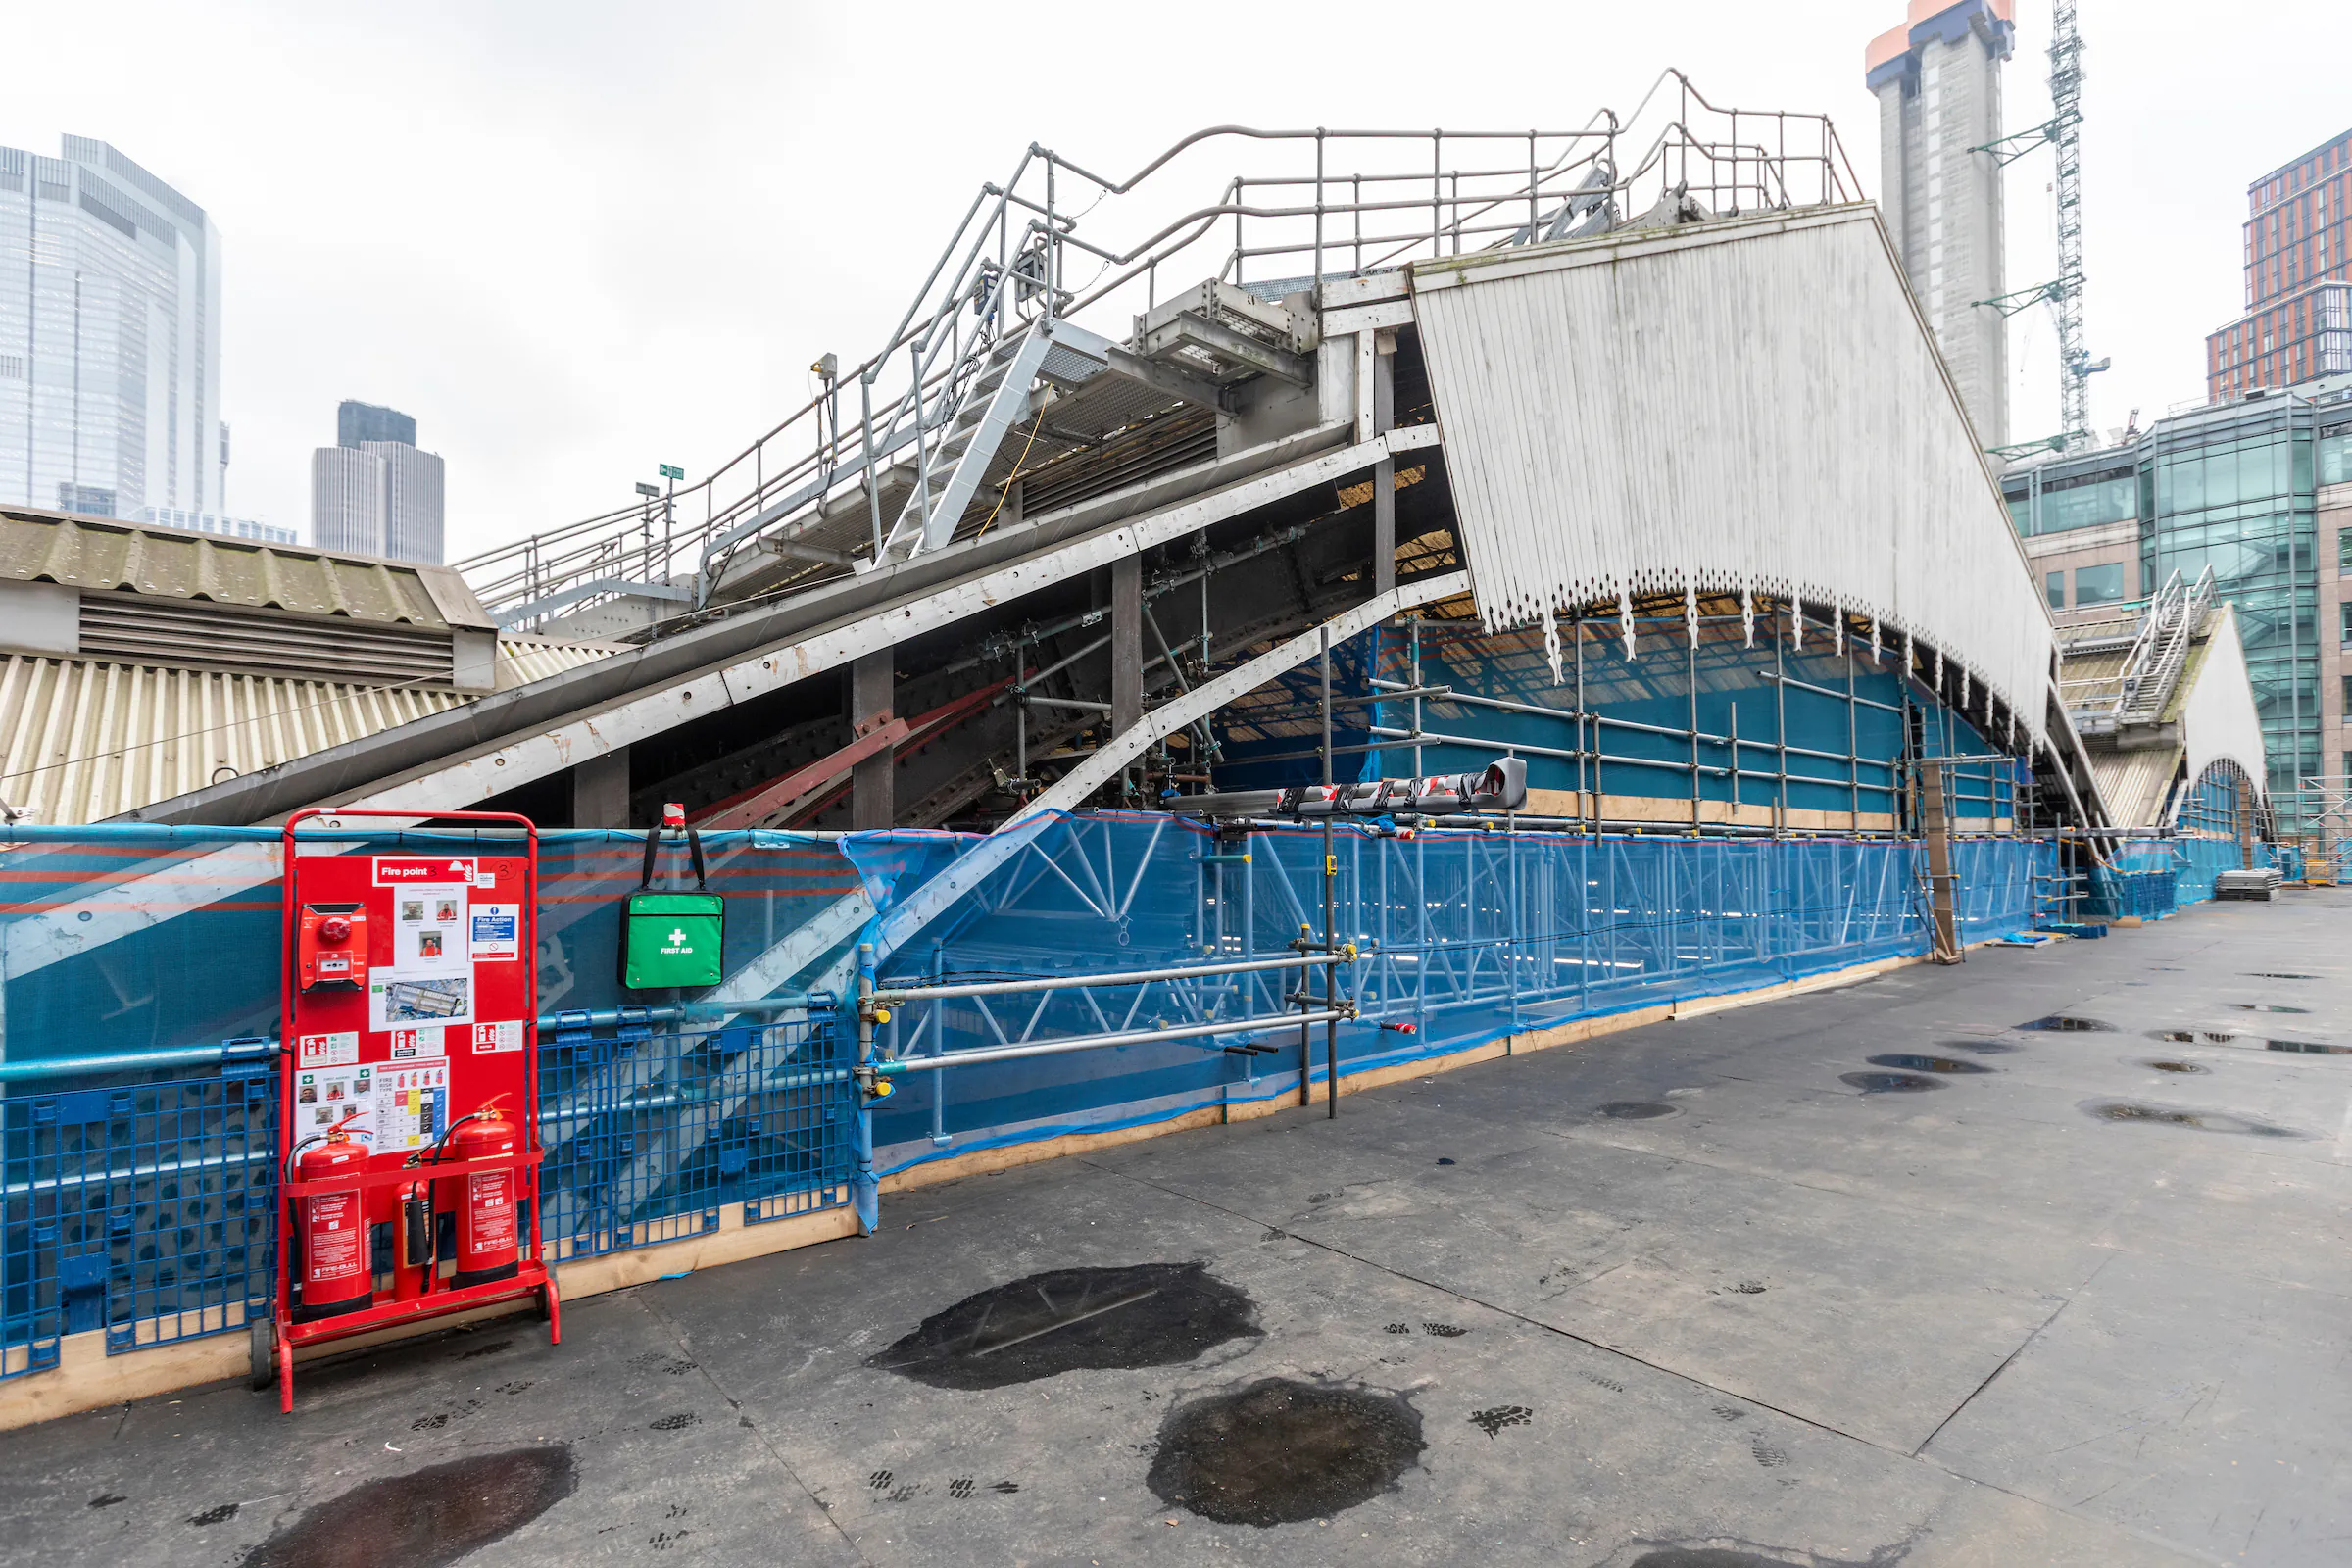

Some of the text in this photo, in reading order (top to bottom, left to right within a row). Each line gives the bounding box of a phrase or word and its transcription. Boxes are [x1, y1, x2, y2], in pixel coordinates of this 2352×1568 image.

[381, 866, 437, 877] Fire point 3
[498, 864, 509, 877] 3
